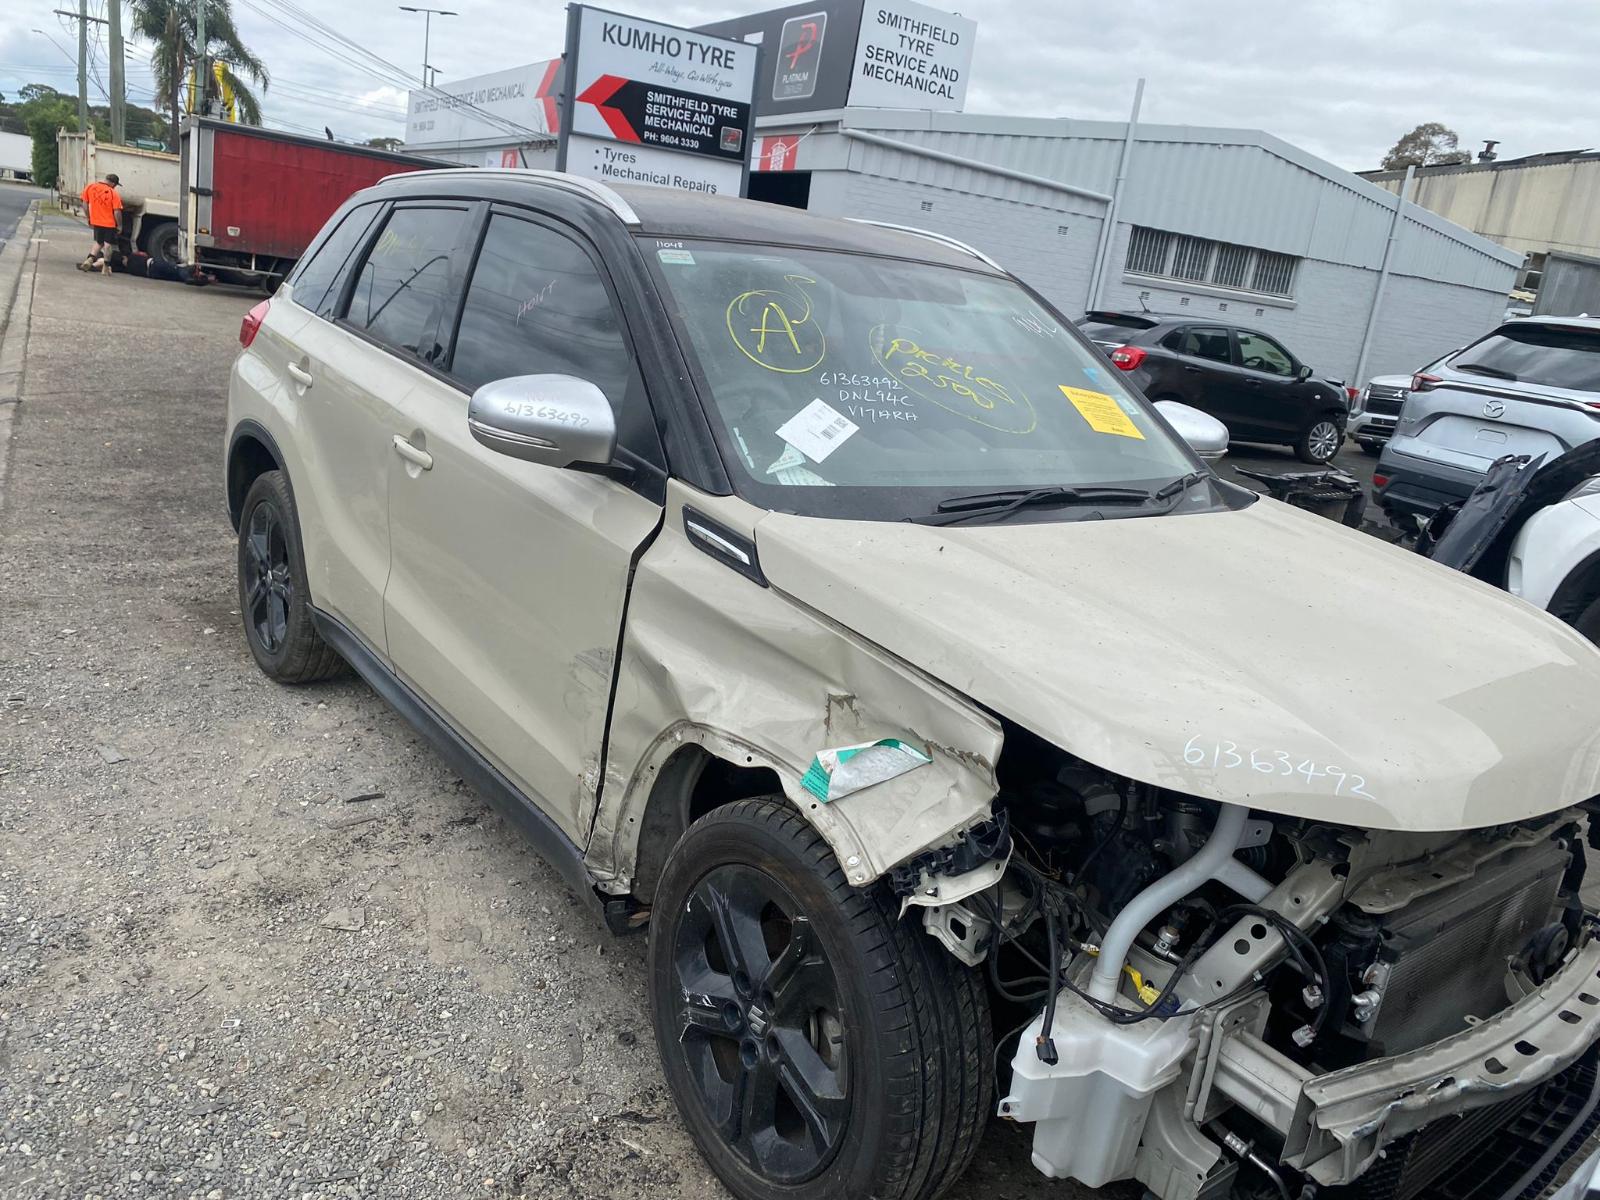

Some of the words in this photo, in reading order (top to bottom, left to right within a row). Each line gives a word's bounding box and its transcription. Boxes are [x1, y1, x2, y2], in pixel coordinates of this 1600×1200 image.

[877, 9, 960, 46] SMITHFIELD
[602, 21, 682, 58] KUMHO
[686, 40, 736, 70] TYRE
[899, 33, 935, 57] TYRE
[865, 44, 927, 74] SERVICE
[929, 63, 959, 83] AND
[486, 81, 526, 103] MECHANICAL
[862, 62, 954, 100] MECHANICAL
[645, 103, 691, 121] SERVICE
[692, 112, 715, 126] AND
[646, 91, 709, 112] SMITHFIELD
[711, 103, 738, 118] TYRE
[644, 115, 713, 137] MECHANICAL
[643, 130, 658, 141] PH:
[660, 134, 679, 145] 9604
[680, 138, 699, 149] 3330
[603, 147, 637, 163] Tyres
[602, 163, 670, 185] Mechanical
[673, 175, 718, 195] Repairs
[820, 371, 903, 390] 61363492
[840, 389, 914, 407] DNL94C
[503, 401, 590, 428] 61363492
[1183, 734, 1377, 800] 61363492
